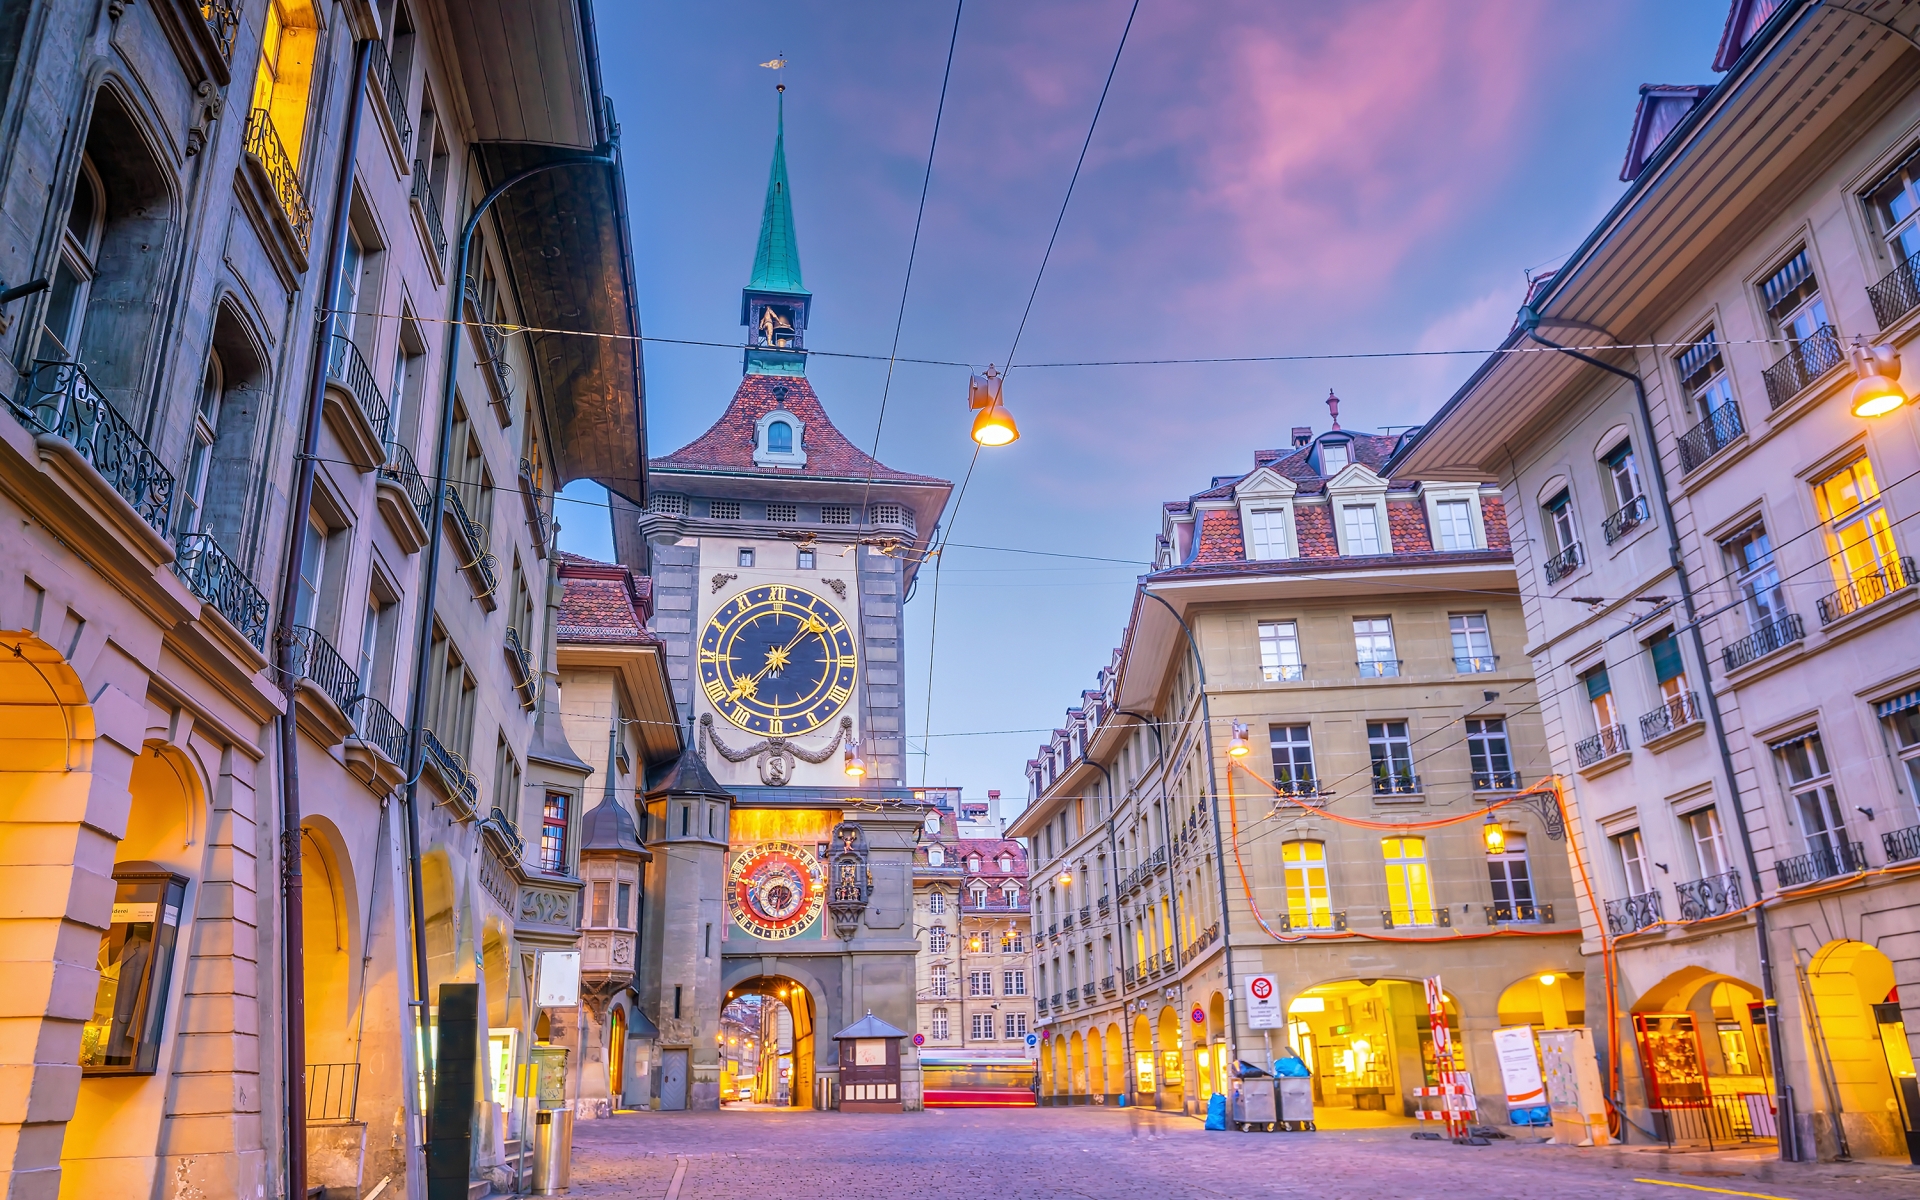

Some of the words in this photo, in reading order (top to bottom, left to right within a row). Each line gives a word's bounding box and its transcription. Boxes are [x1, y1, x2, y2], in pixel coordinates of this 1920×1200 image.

[768, 586, 786, 601] XII
[736, 594, 753, 611] XI
[808, 597, 817, 610] I
[711, 618, 725, 632] X
[831, 621, 845, 634] II
[701, 648, 716, 663] IX
[840, 655, 855, 668] III
[828, 685, 848, 704] IIII
